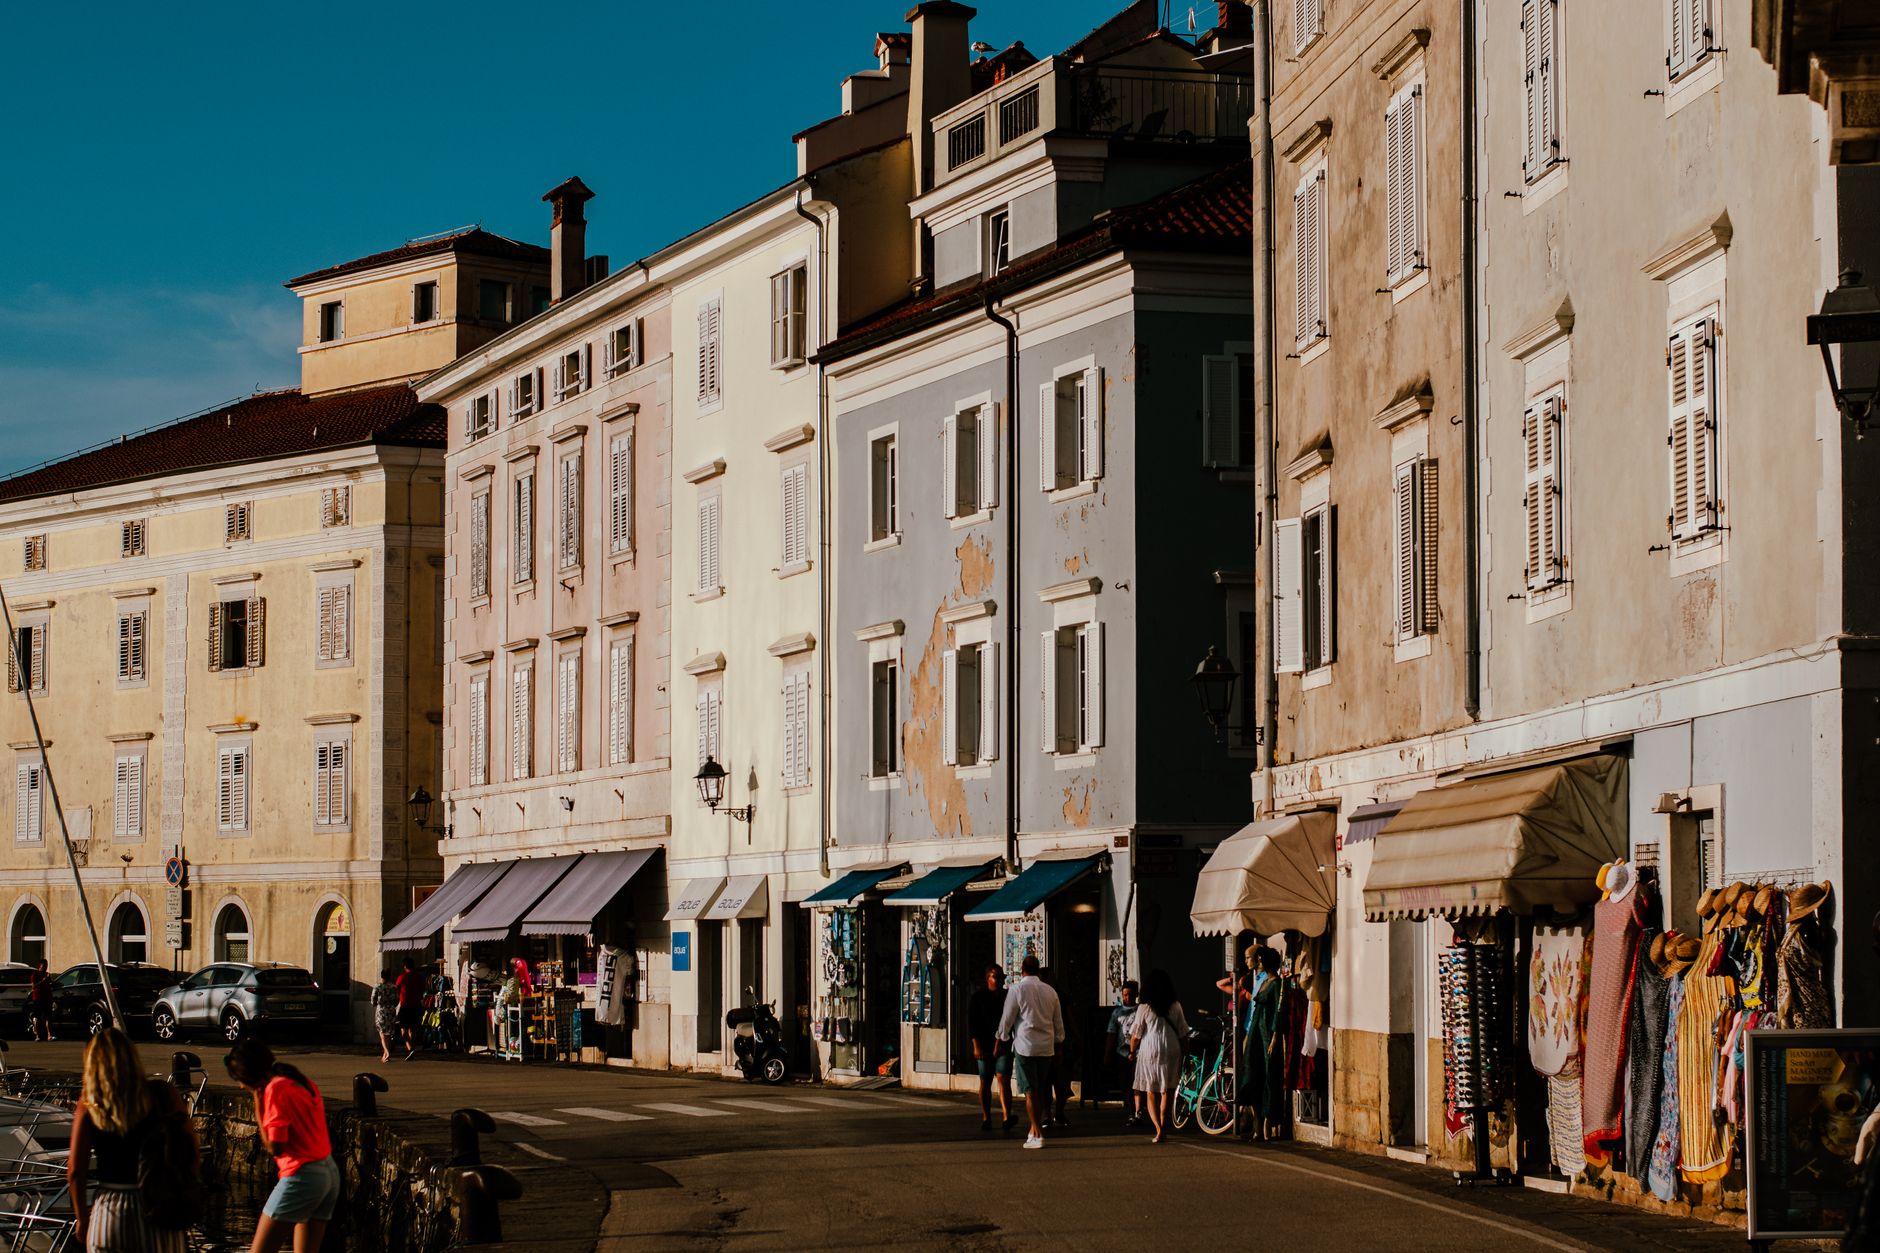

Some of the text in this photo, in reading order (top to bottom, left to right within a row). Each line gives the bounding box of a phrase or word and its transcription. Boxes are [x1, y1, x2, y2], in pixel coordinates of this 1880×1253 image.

[1790, 1050, 1833, 1058] HAND MADE
[1790, 1067, 1833, 1075] MAGNETS
